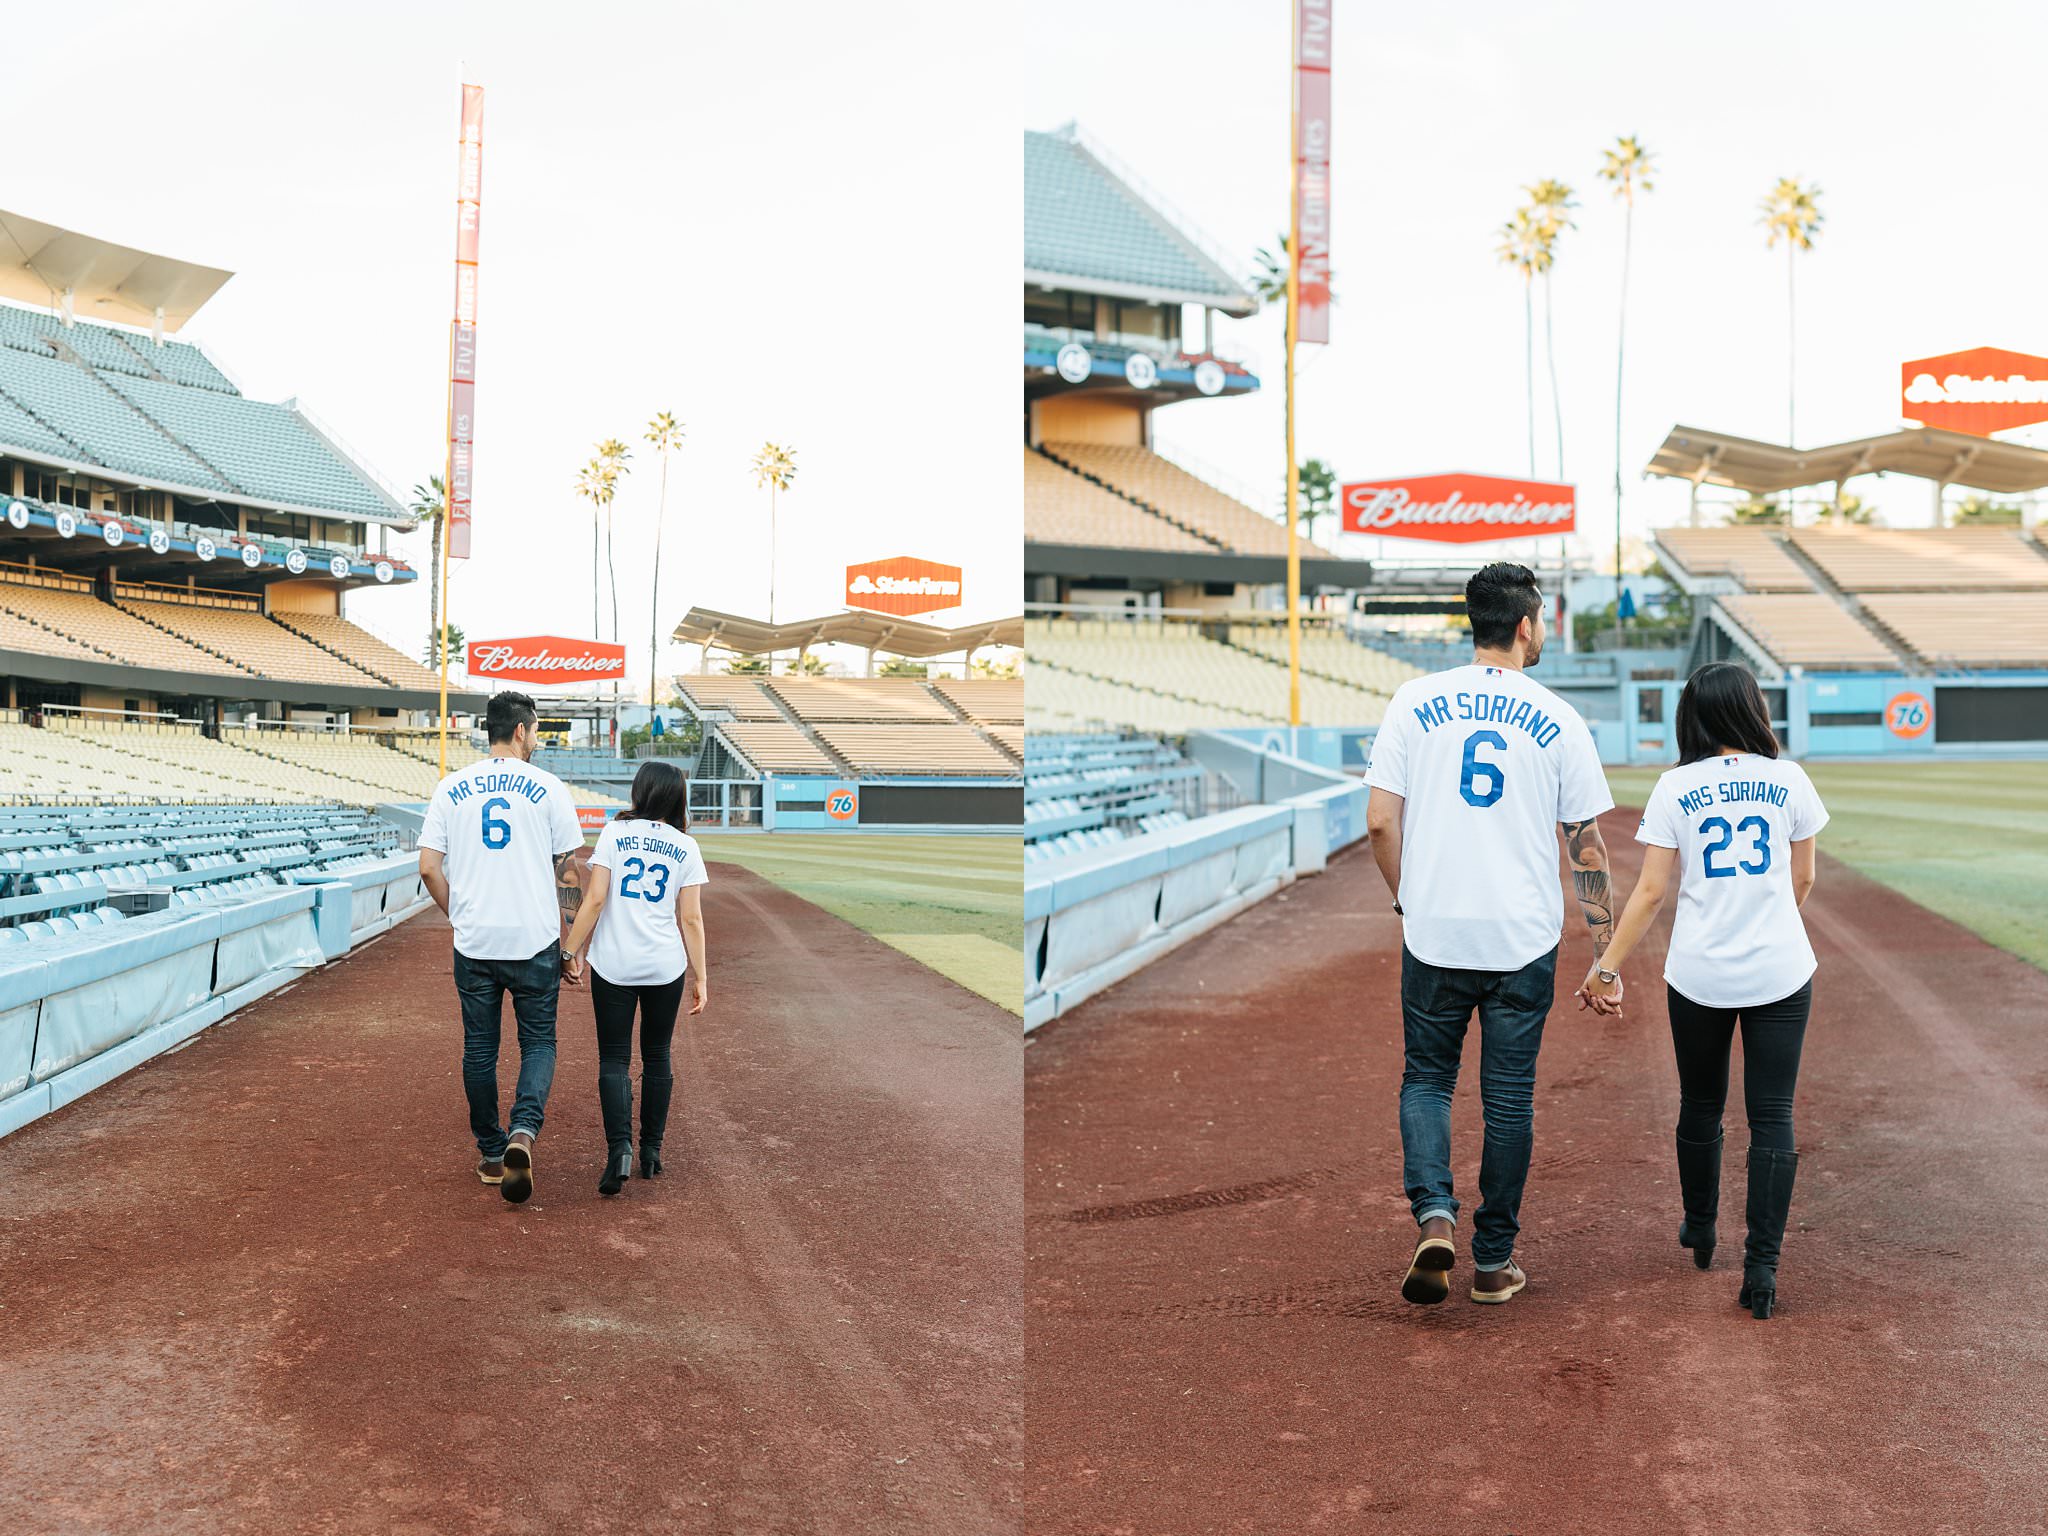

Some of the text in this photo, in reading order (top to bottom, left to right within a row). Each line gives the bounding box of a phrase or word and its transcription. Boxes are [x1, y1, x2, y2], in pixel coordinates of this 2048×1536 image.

[456, 347, 474, 375] Fly
[453, 414, 469, 487] Emirates
[1349, 487, 1573, 528] Budweiser
[61, 518, 72, 532] 19
[106, 527, 120, 541] 20
[153, 535, 166, 549] 24
[200, 543, 213, 557] 32
[245, 549, 258, 563] 39
[288, 553, 306, 570] 42
[333, 560, 346, 574] 53
[474, 645, 623, 672] Budweiser
[1413, 692, 1561, 749] MR SORIANO
[1895, 702, 1925, 726] 76
[1459, 730, 1508, 808] 6
[447, 773, 547, 806] MR SORIANO
[1678, 781, 1789, 816] MRS SORIANO
[832, 795, 853, 813] 76
[482, 797, 511, 850] 6
[616, 836, 687, 863] MRS SORIANO
[1699, 815, 1772, 878] 23
[620, 857, 670, 903] 23
